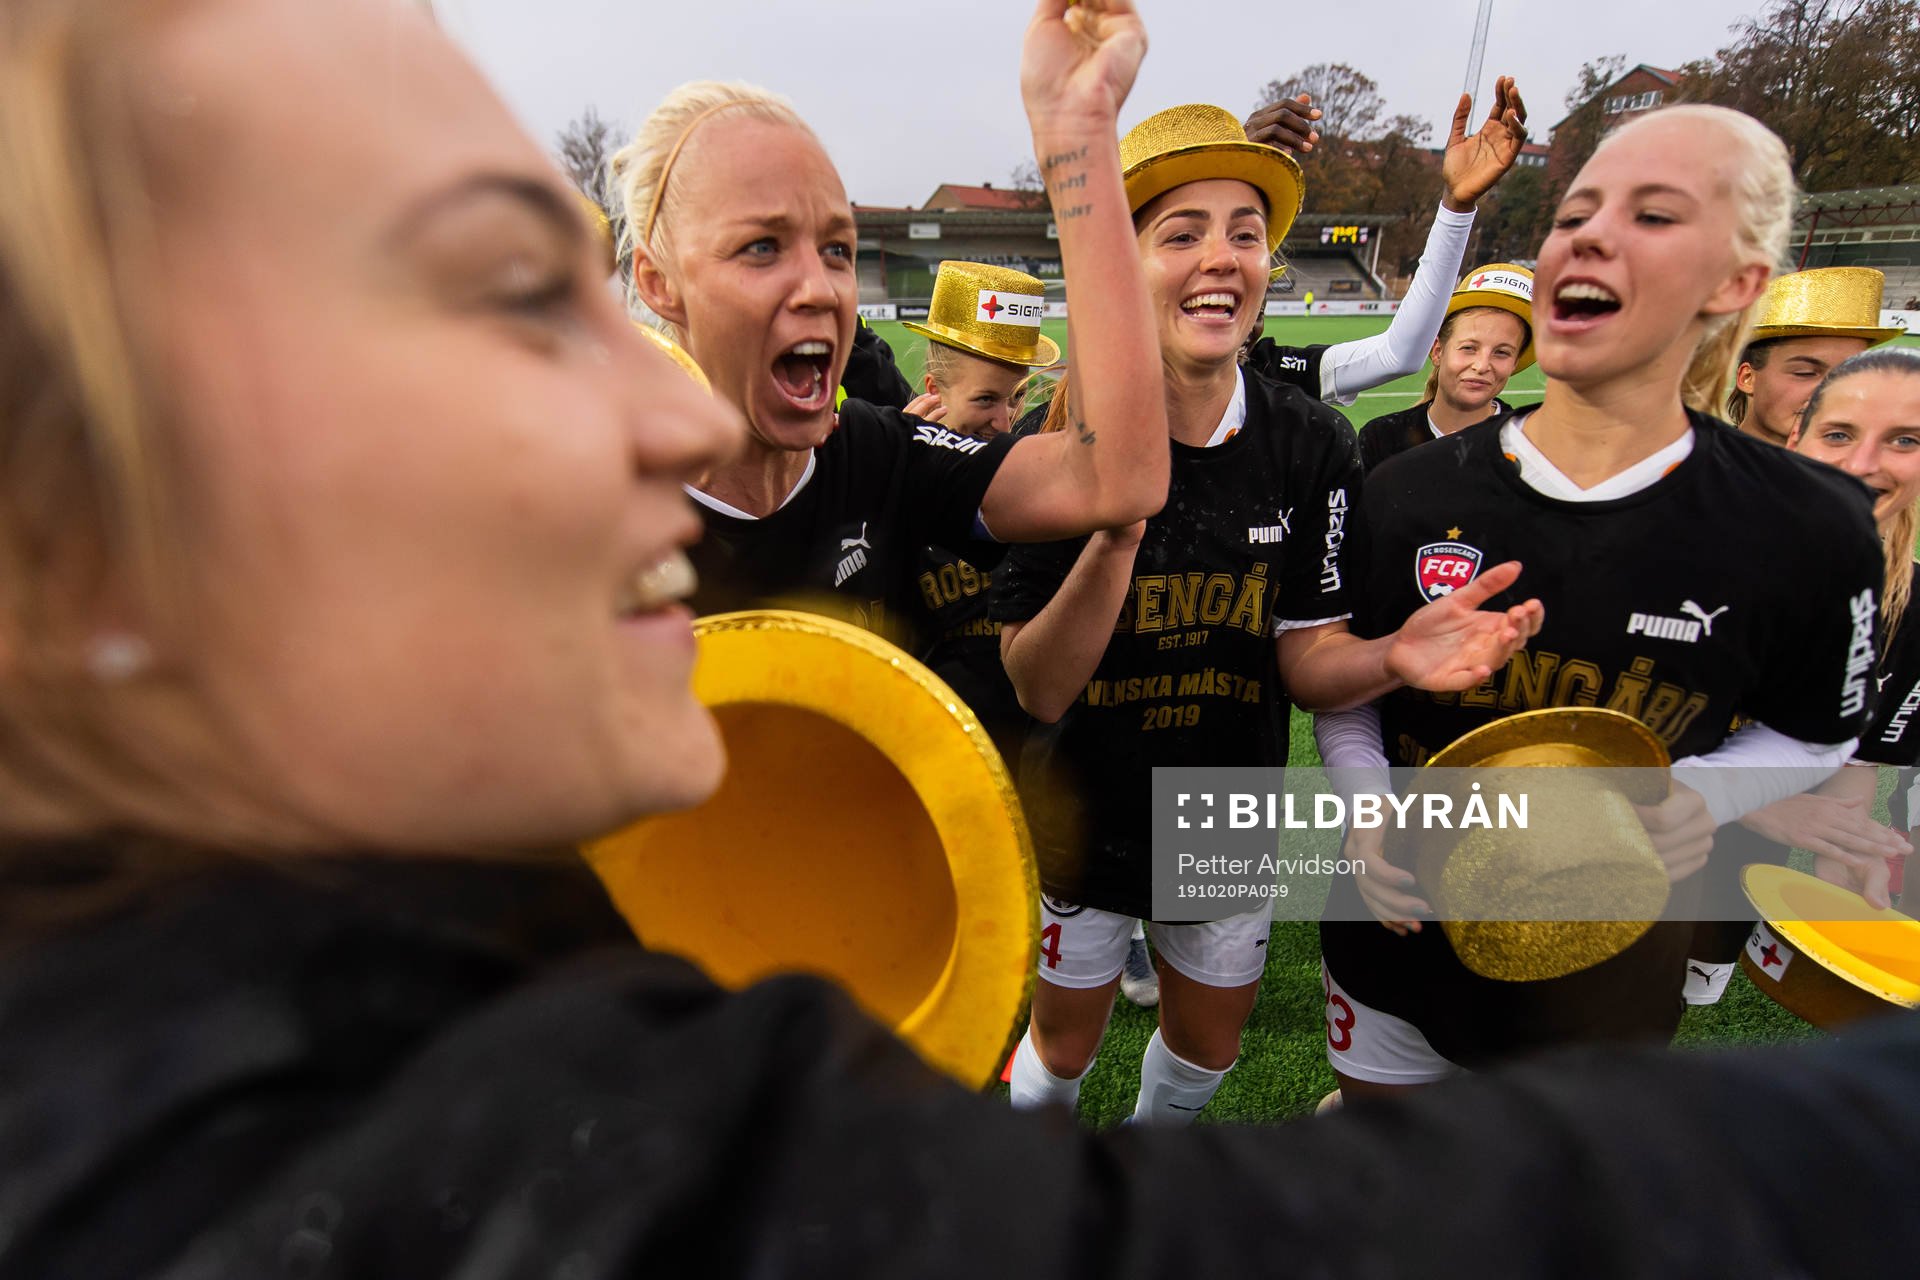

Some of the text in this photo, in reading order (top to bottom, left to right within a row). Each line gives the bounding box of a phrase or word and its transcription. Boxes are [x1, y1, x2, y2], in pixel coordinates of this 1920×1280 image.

[1423, 559, 1470, 578] FCR
[1156, 630, 1209, 650] EST. 1917
[1626, 612, 1702, 643] PUMA
[1839, 587, 1877, 718] stadium
[1141, 704, 1200, 731] 2019
[1880, 680, 1920, 743] dium
[1325, 968, 1356, 1052] 3
